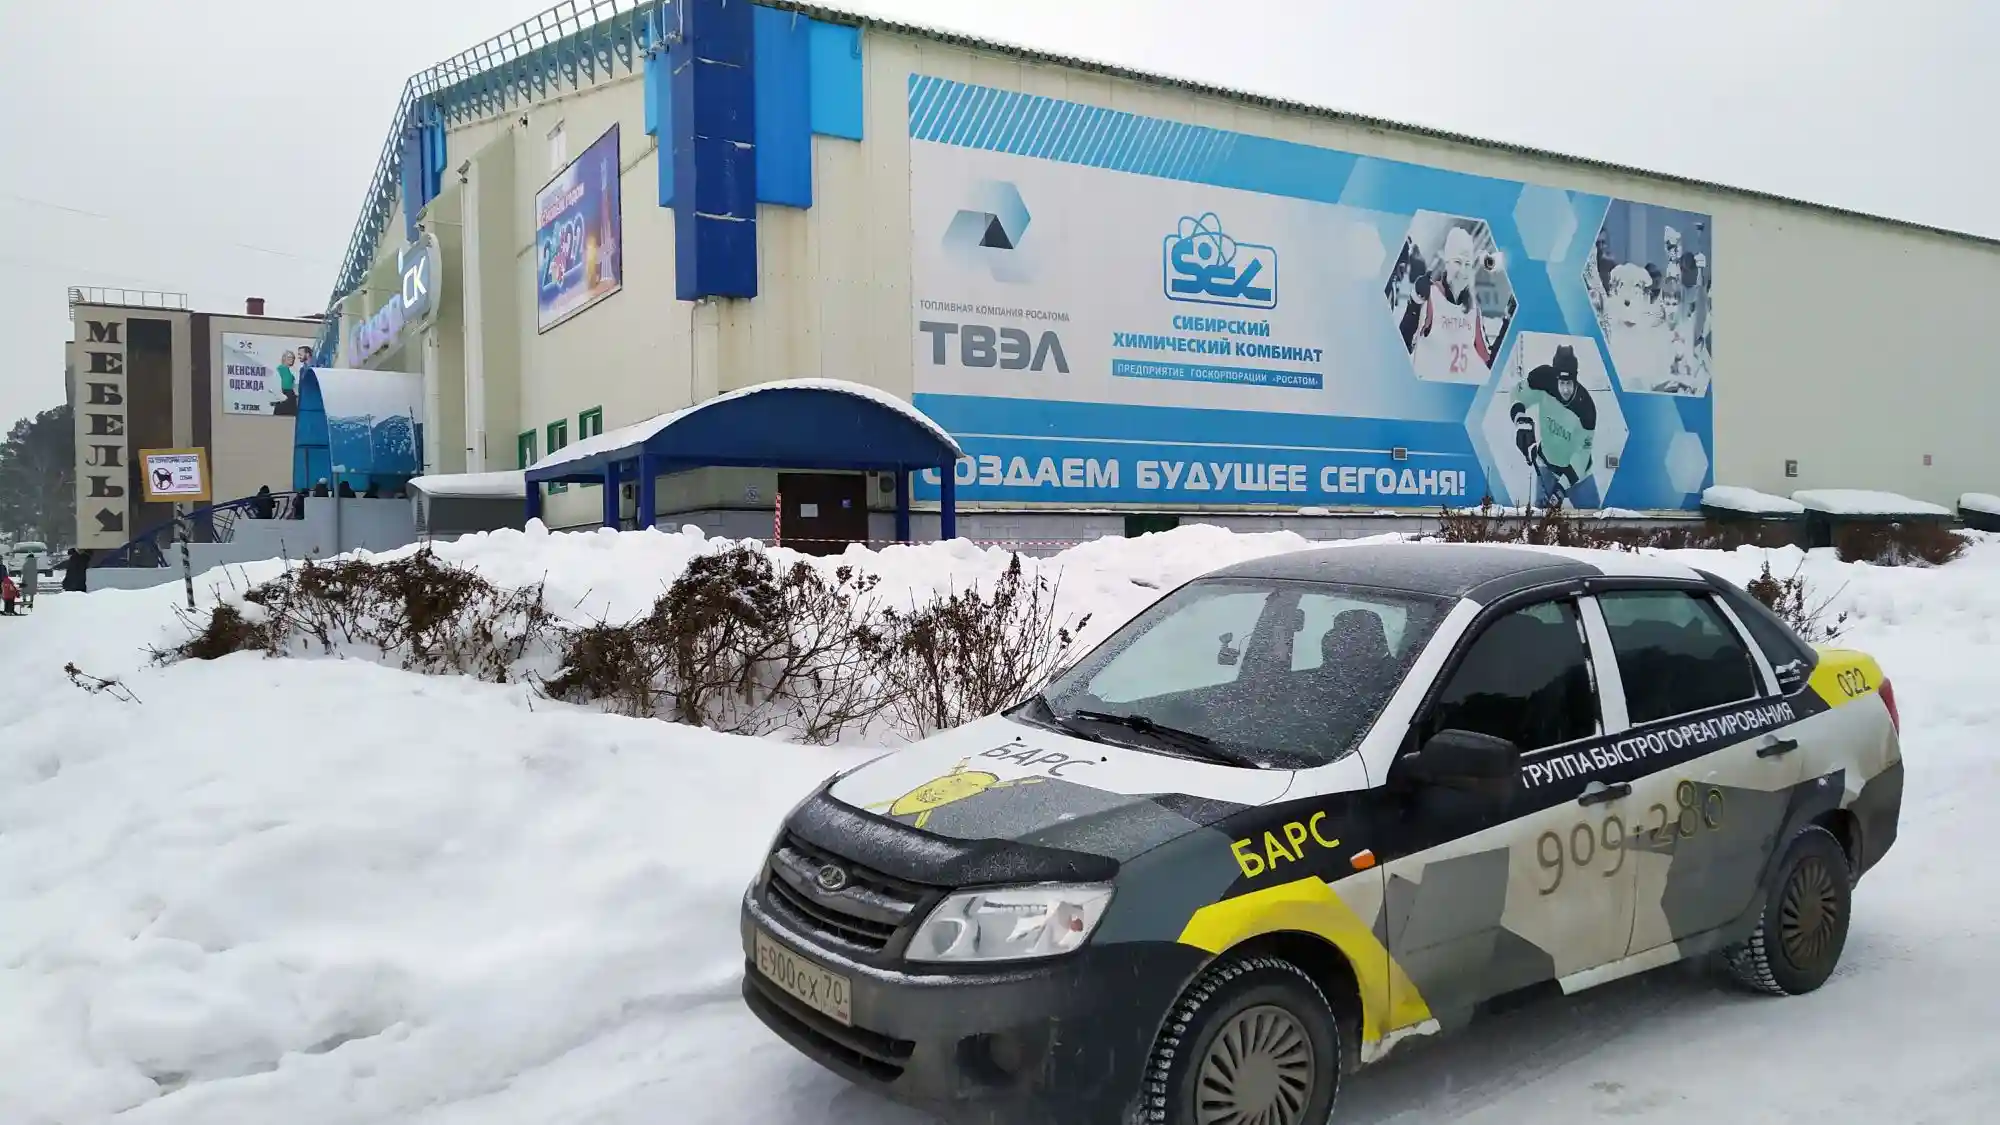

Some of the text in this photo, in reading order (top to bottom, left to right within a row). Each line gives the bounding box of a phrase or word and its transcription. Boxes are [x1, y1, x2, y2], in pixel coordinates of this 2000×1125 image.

[920, 300, 1070, 322] ТОПЛИВНАЯ КОМПАНИЯ РОСАТОМА
[1172, 315, 1270, 337] СИБИРСКИЙ
[919, 320, 1070, 374] ТВЭЛ
[1112, 332, 1323, 363] ХИМИЧЕСКИЙ КОМБИНАТ
[1449, 343, 1468, 373] 25
[227, 364, 267, 377] ЖЕНСКАЯ
[229, 379, 264, 391] ОДЕЖДА
[1117, 363, 1185, 377] ПРЕДПРИЯТИЕ
[1190, 369, 1267, 383] ГОСКОРПОРАЦИИ
[84, 320, 124, 498] МЕБЕЛЬ
[234, 402, 240, 411] 3
[1136, 460, 1307, 491] БУДУЩЕЕ
[1320, 465, 1466, 496] СЕГОДНЯ!
[1837, 667, 1872, 697] 022
[979, 742, 1096, 777] БАРС
[1521, 755, 1594, 789] ГРУППА
[1230, 810, 1340, 878] БАРС
